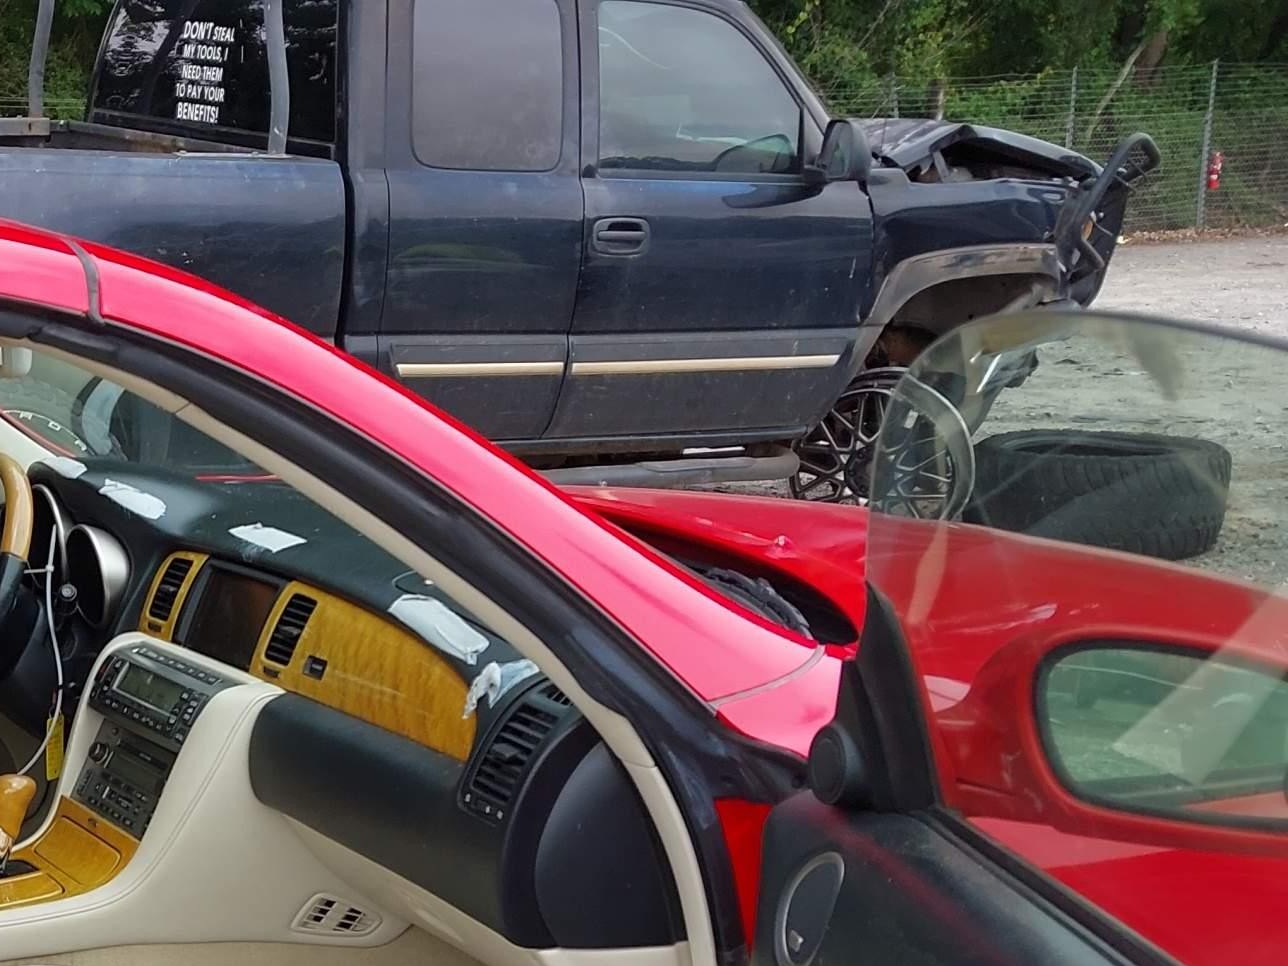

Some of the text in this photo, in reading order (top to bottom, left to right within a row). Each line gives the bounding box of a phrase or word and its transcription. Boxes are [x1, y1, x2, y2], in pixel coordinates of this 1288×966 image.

[183, 20, 235, 42] DON'T STEAL
[183, 44, 229, 62] MY TOOLS, I
[182, 65, 223, 82] NEED THEM
[176, 83, 225, 102] TO PAY YOUR
[177, 101, 219, 123] BENEFITS!
